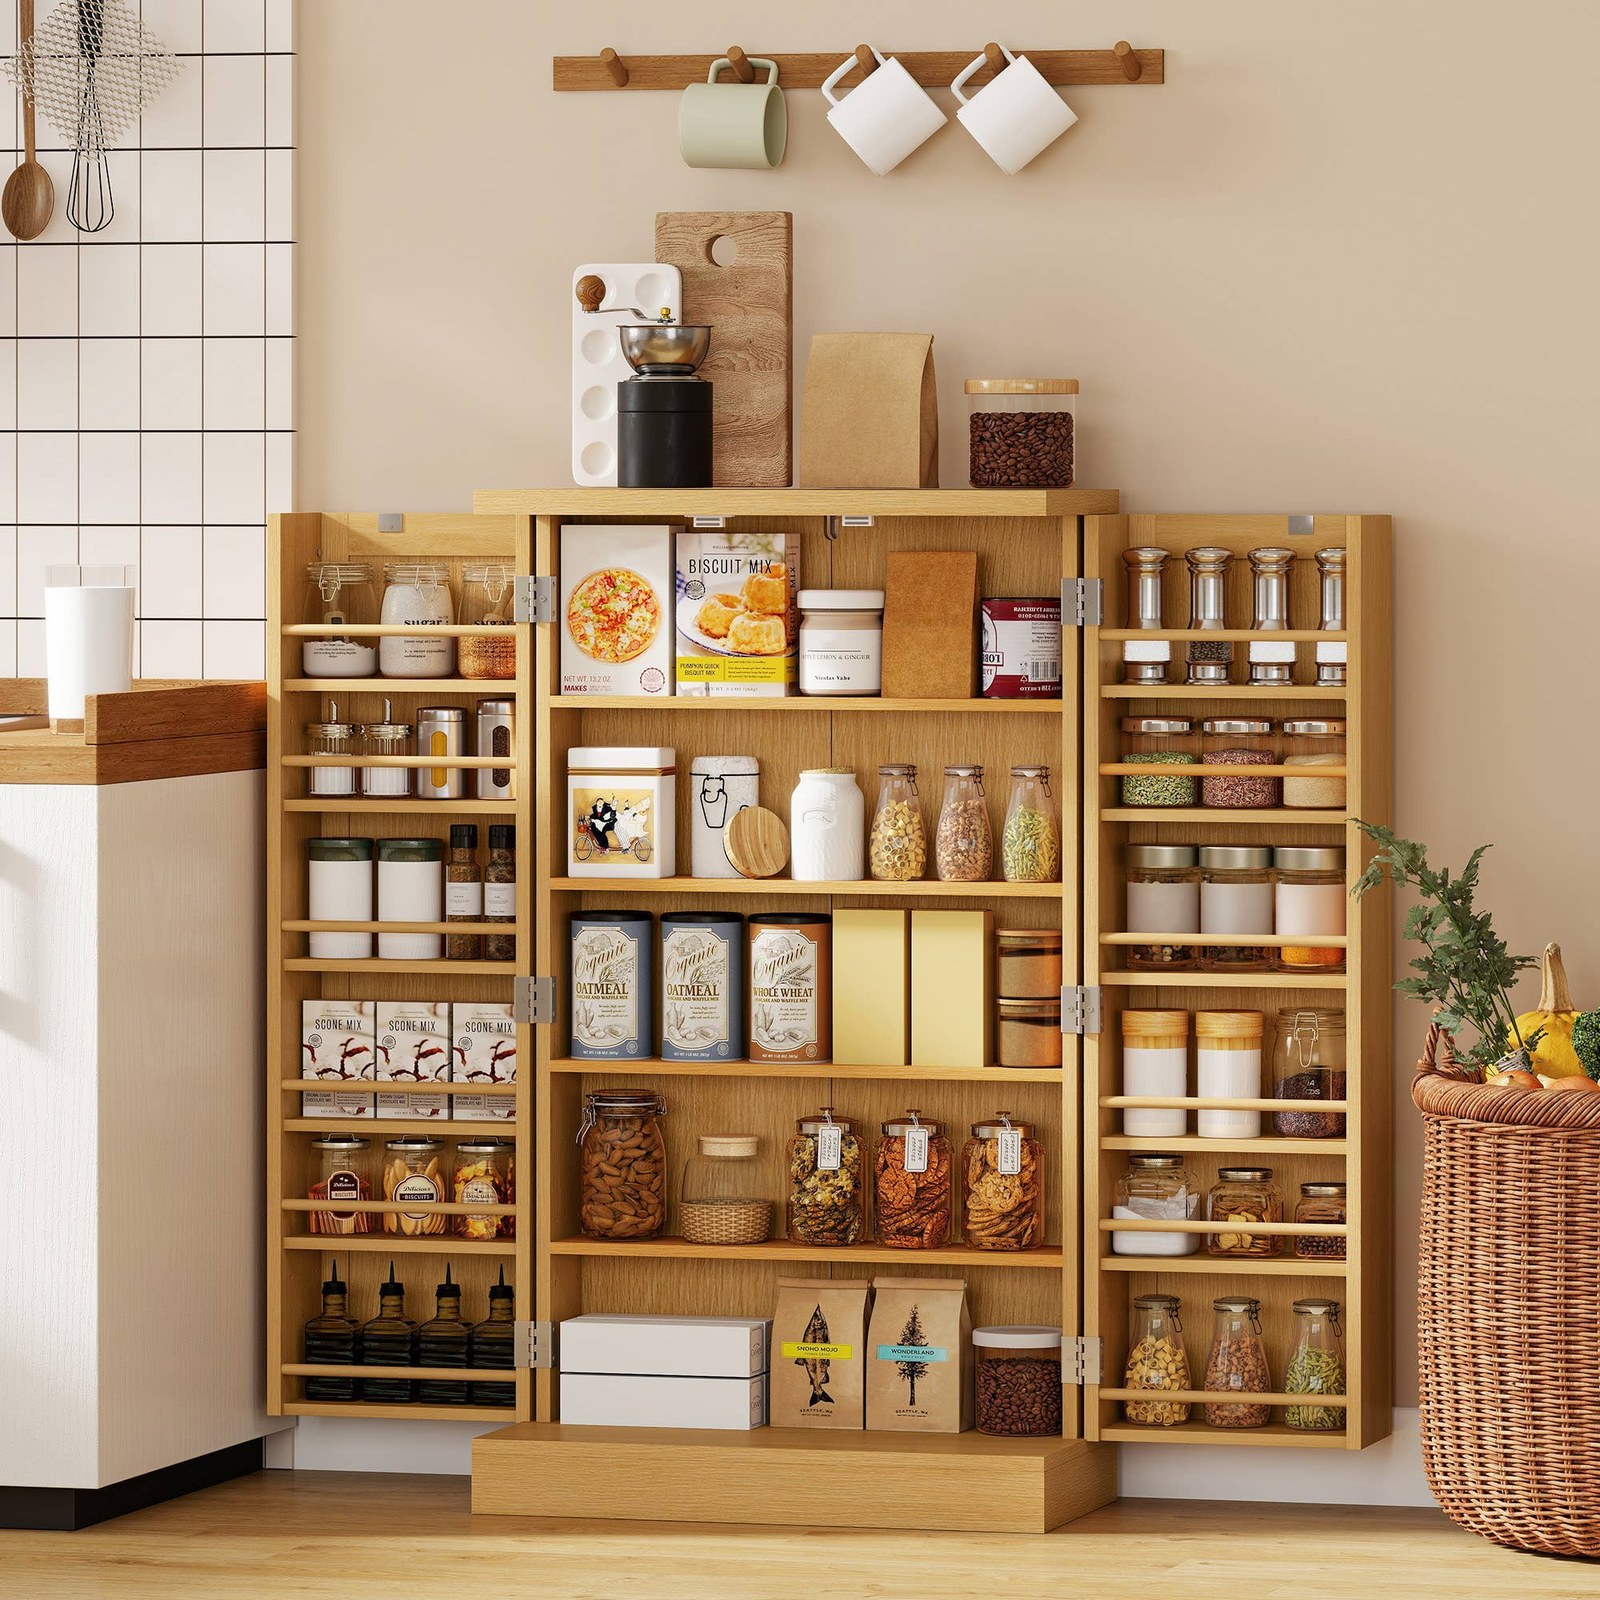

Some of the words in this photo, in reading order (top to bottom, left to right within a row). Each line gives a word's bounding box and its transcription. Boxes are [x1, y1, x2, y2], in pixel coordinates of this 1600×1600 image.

[689, 559, 741, 574] BISCUIT
[749, 560, 772, 574] MIX
[575, 941, 626, 978] Organic
[666, 943, 718, 980] Organic
[754, 944, 806, 981] Organic
[576, 982, 628, 995] OATMEAL
[667, 983, 720, 996] OATMEAL
[753, 987, 779, 997] WHOLE
[780, 987, 814, 997] WHEAT
[315, 1019, 343, 1030] SCONE
[346, 1019, 362, 1031] MIX
[389, 1020, 417, 1032] SCONE
[420, 1021, 436, 1032] MIX
[465, 1021, 493, 1033] SCONE
[497, 1022, 513, 1033] MIX
